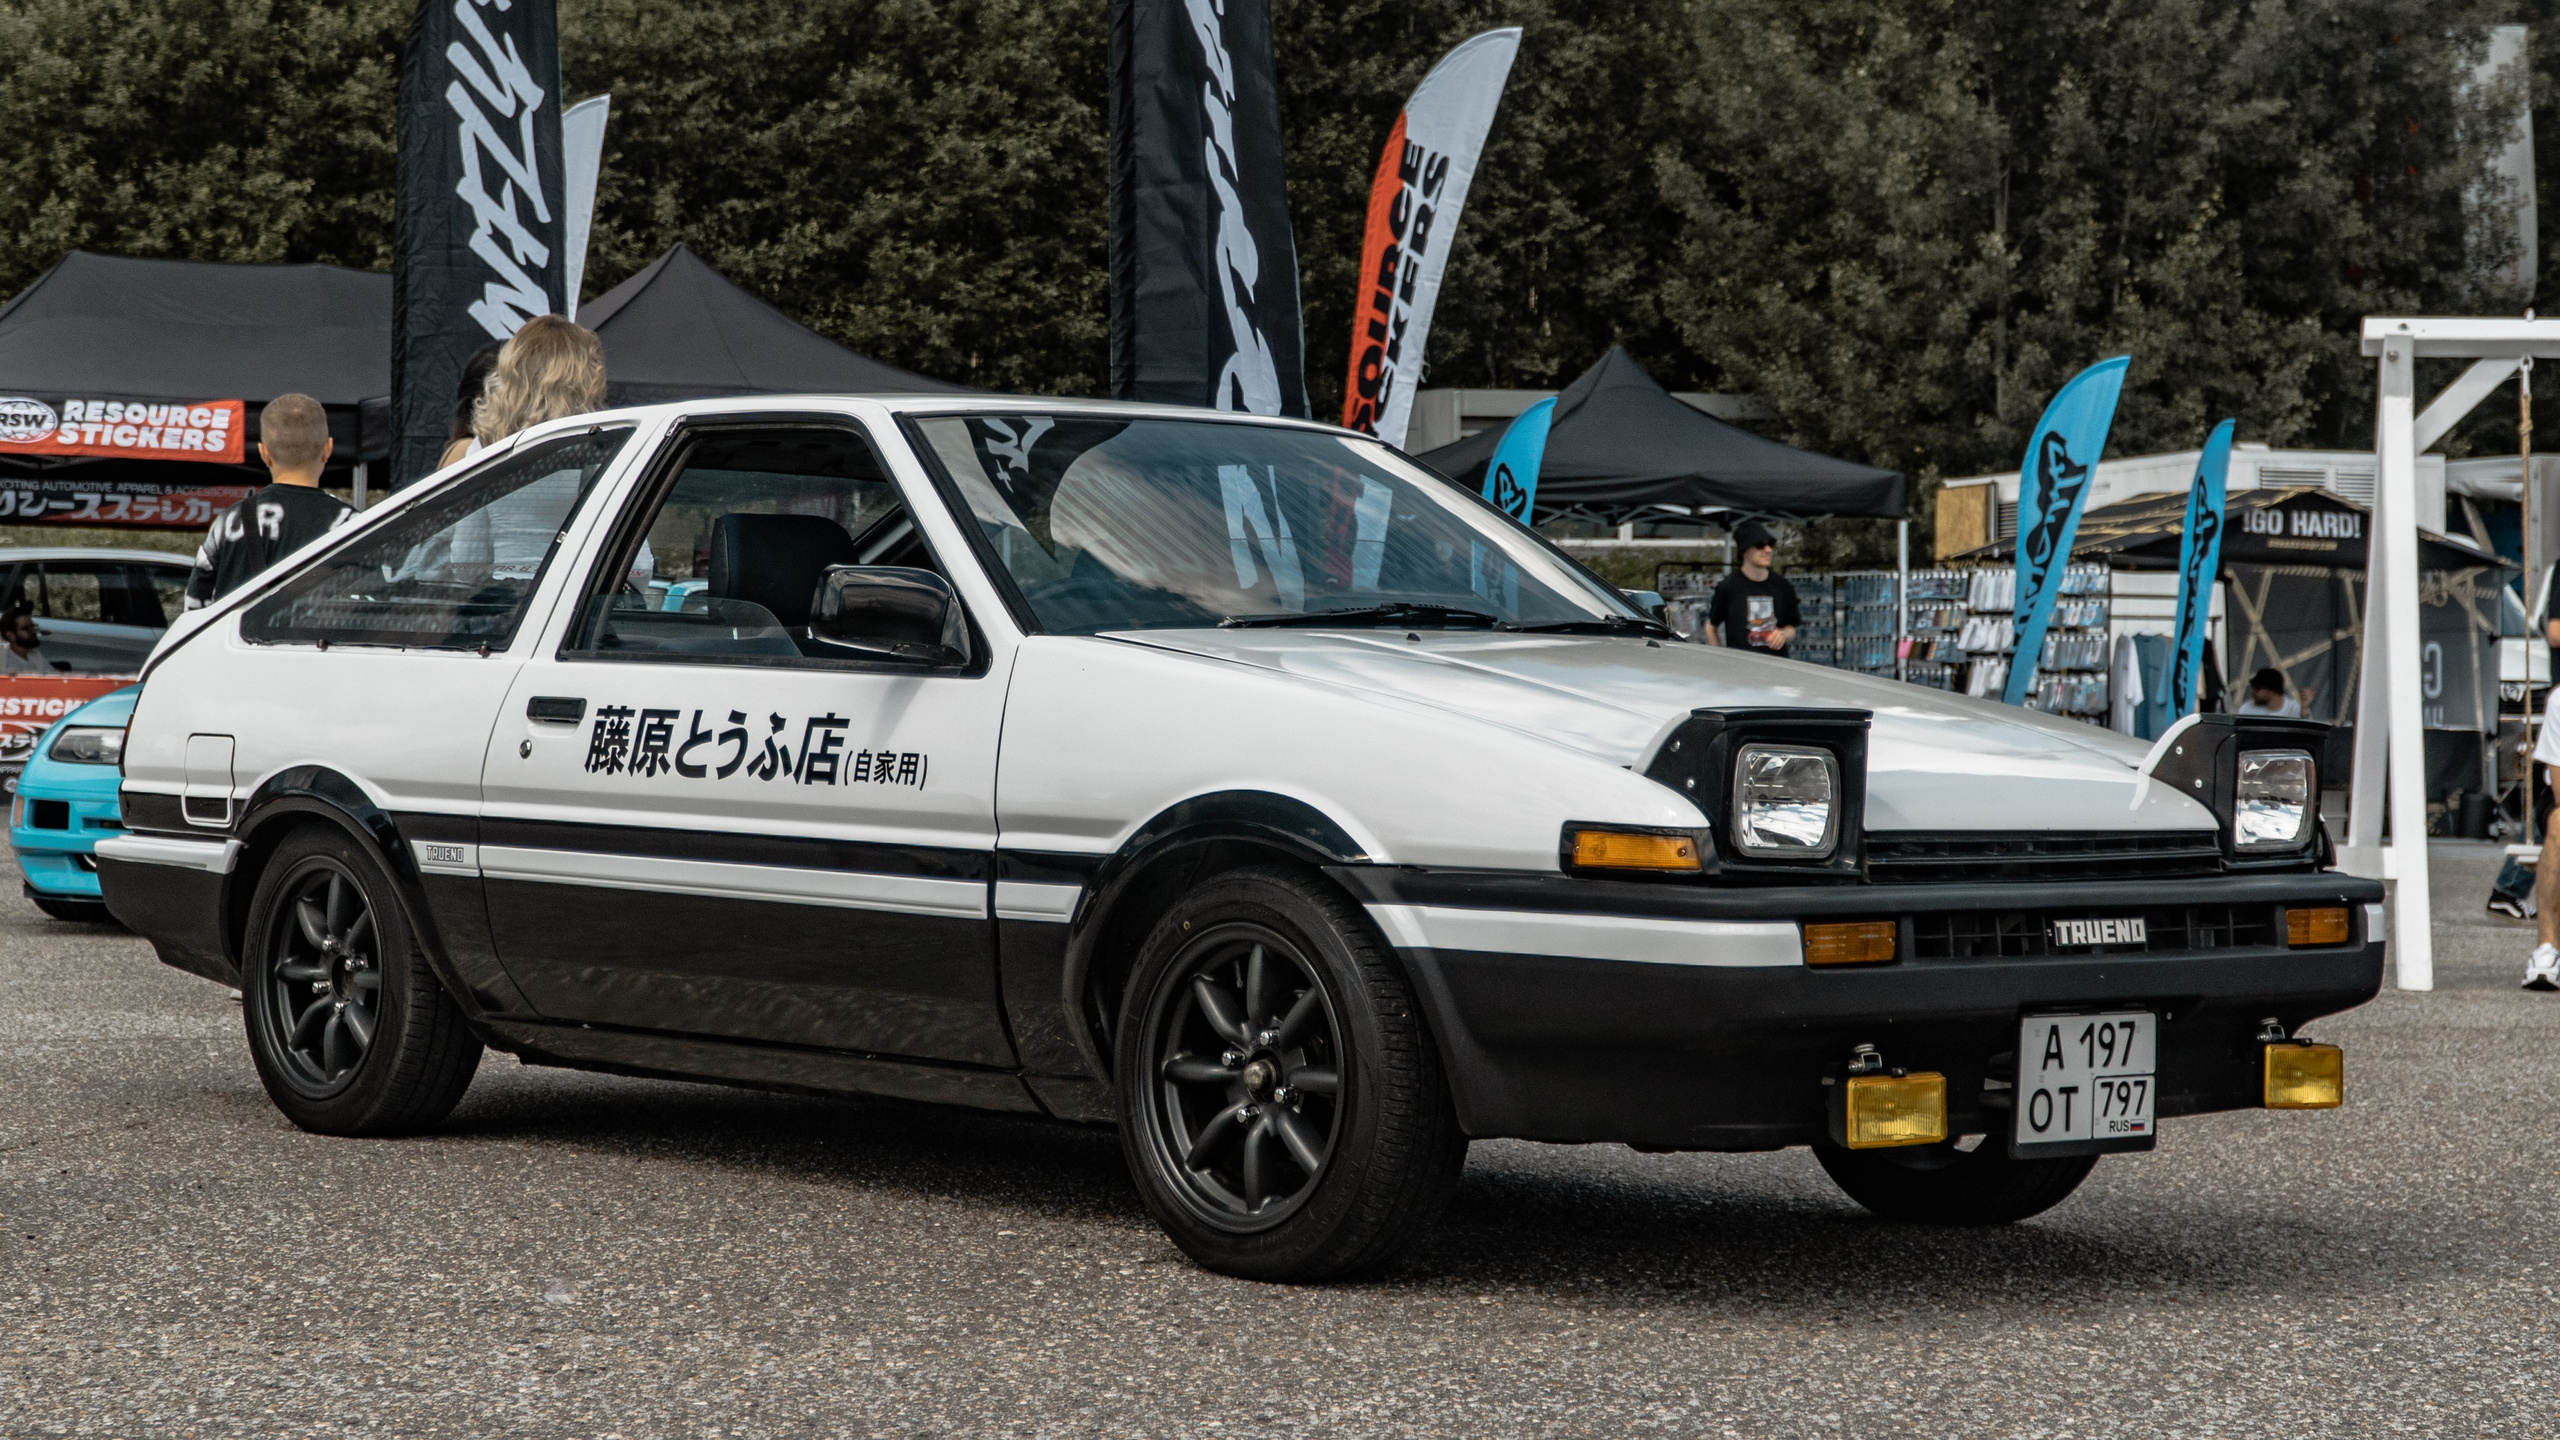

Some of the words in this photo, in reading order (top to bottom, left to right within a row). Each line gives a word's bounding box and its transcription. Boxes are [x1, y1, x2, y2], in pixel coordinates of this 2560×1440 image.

[0, 412, 47, 428] RSW
[63, 400, 231, 430] RESOURCE
[57, 421, 227, 452] STICKERS
[42, 481, 112, 492] AUTOMOTIVE
[117, 483, 162, 494] APPAREL
[2291, 510, 2361, 538] HARD!
[0, 697, 88, 716] STICK
[426, 845, 464, 862] TRUENO
[2055, 918, 2146, 945] TRUENO
[2042, 1024, 2064, 1070] A
[2079, 1020, 2136, 1069] 197
[2029, 1086, 2079, 1133] OT
[2100, 1080, 2148, 1118] 797
[2109, 1120, 2130, 1133] RUS
